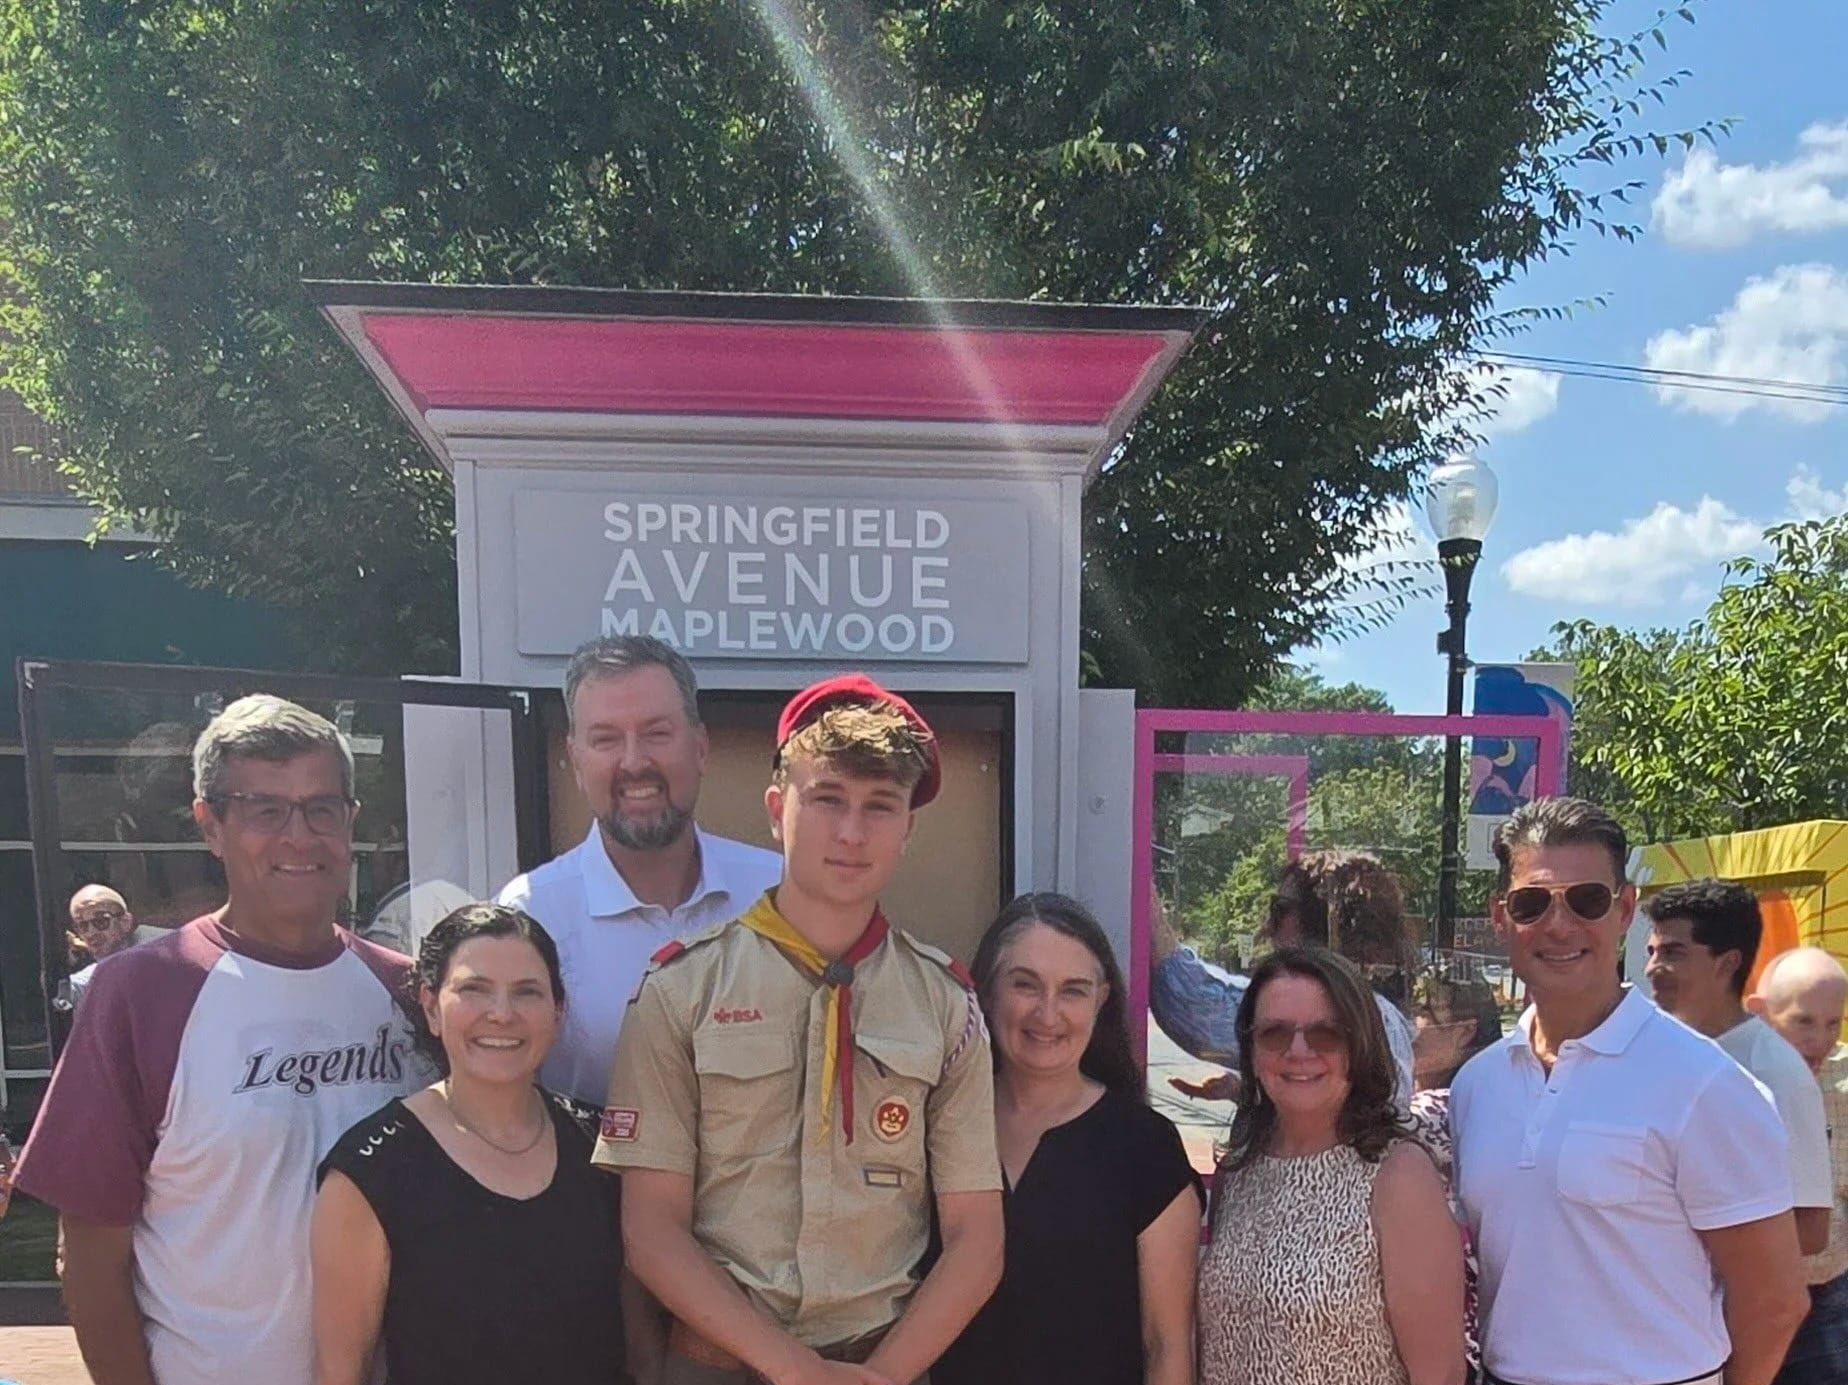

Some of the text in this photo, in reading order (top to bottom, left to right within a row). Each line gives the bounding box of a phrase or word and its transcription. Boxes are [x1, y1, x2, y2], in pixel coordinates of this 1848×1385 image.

[604, 502, 950, 549] SPRINGFIELD
[604, 548, 950, 609] AVENUE
[601, 608, 954, 653] MAPLEWOOD
[233, 1023, 404, 1097] Legends
